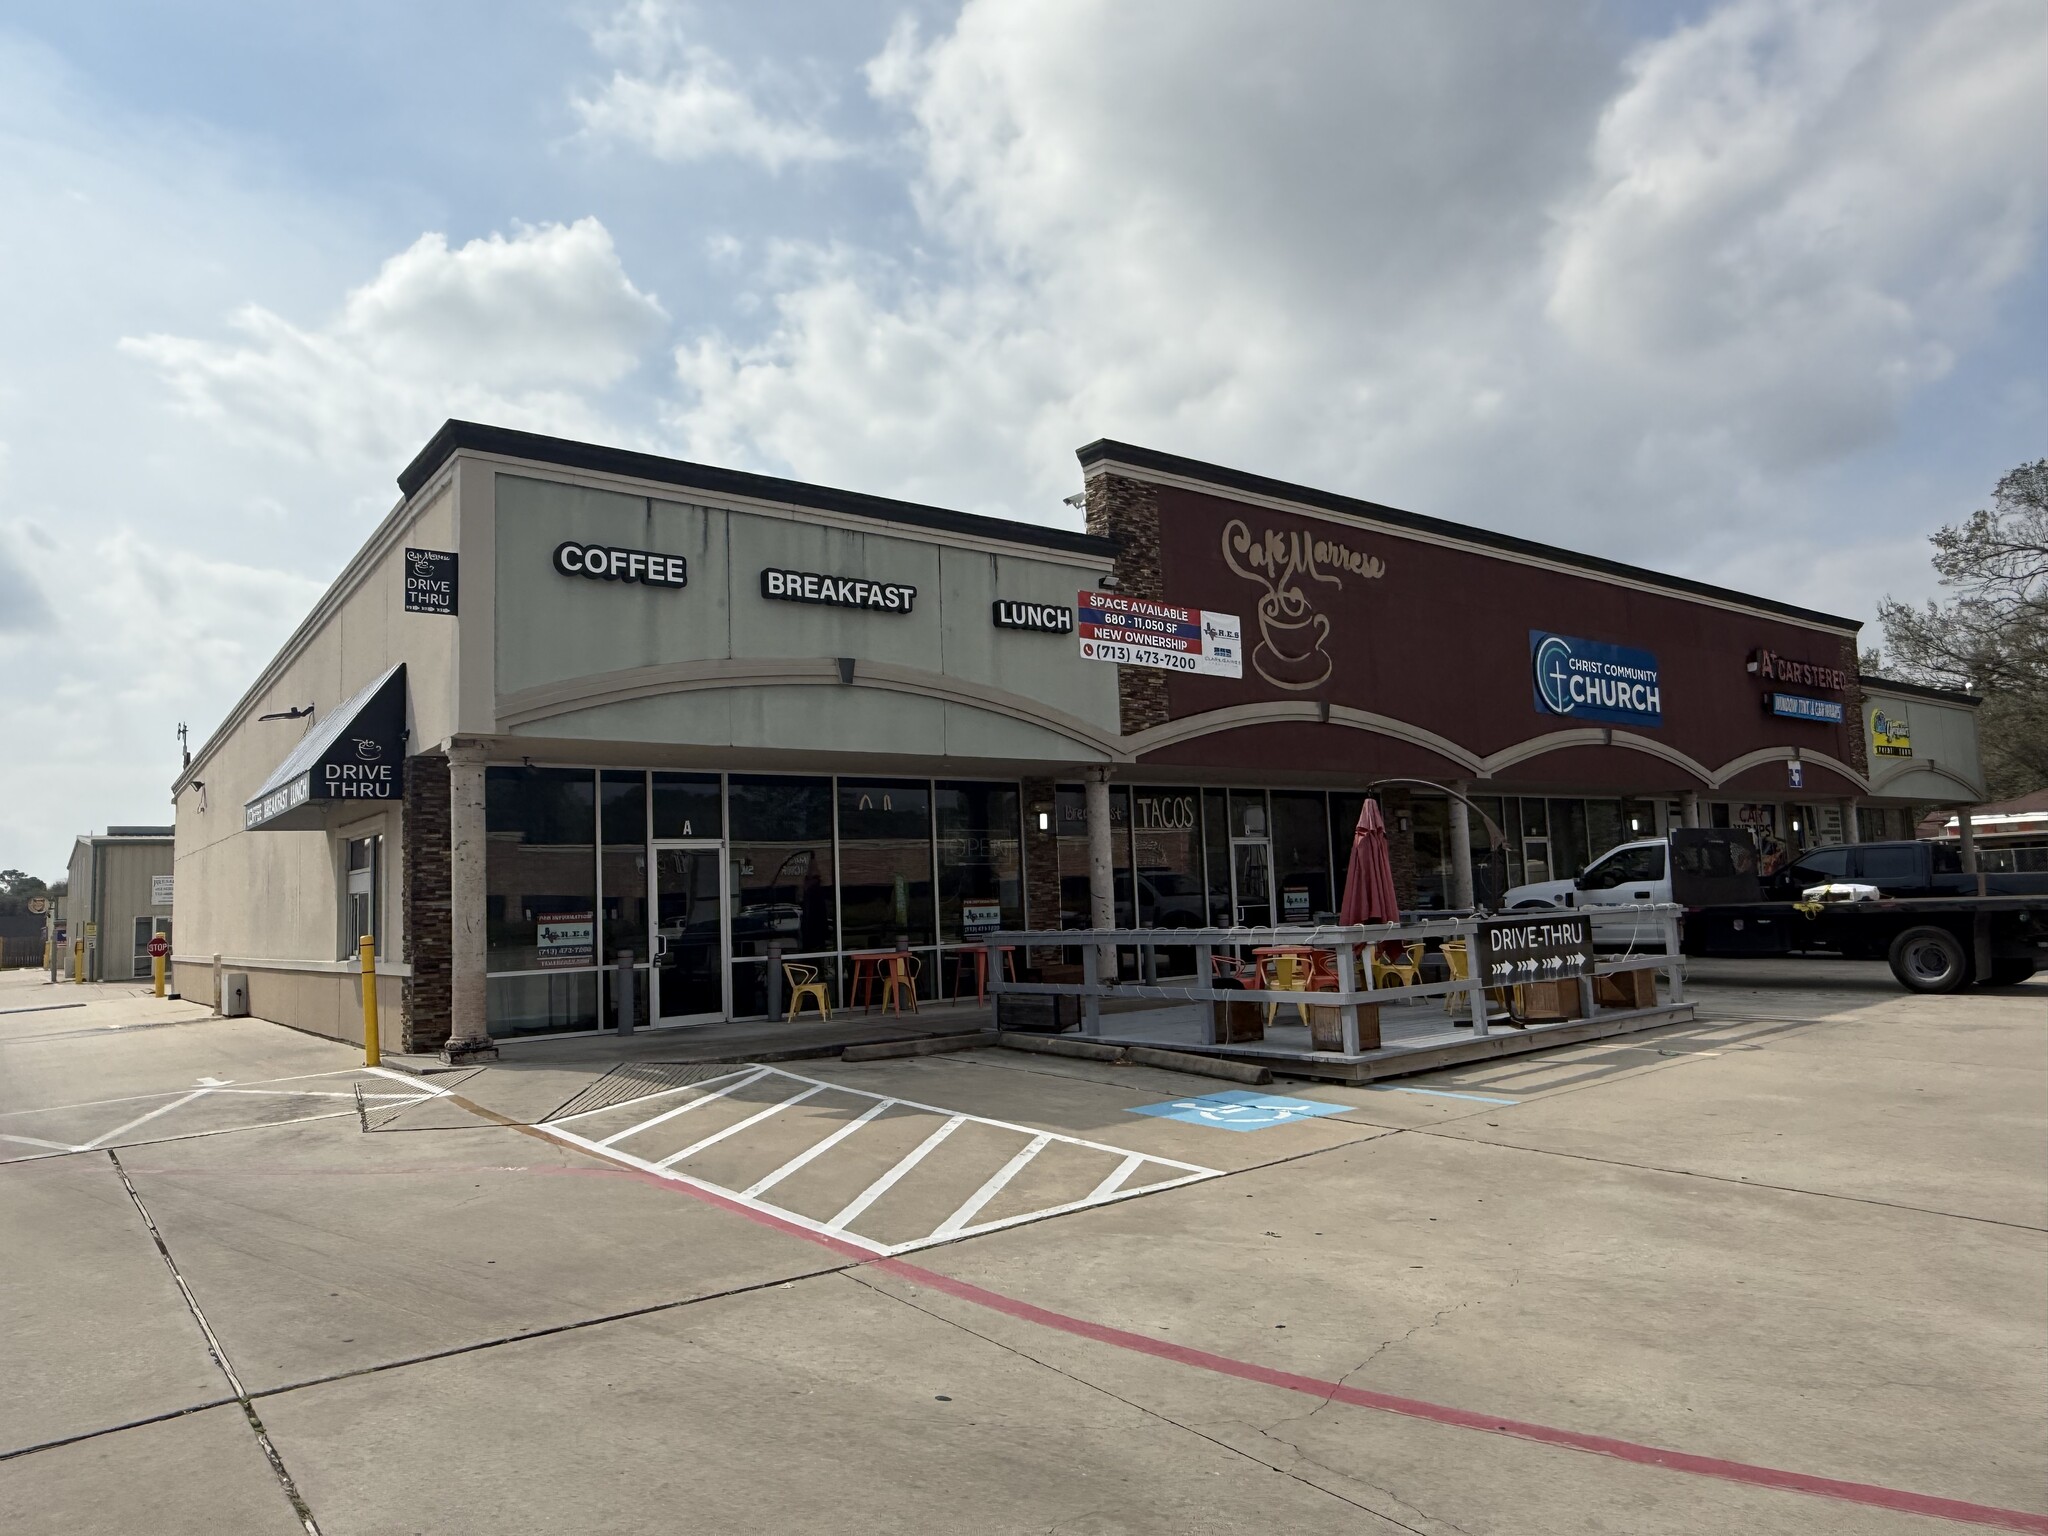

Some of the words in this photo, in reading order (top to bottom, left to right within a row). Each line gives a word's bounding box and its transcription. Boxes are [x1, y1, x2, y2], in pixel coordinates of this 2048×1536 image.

[560, 546, 684, 583] COFFEE
[407, 577, 450, 593] DRIVE
[768, 571, 914, 609] BREAKFAST
[408, 591, 449, 606] THRU
[1090, 594, 1128, 611] SPACE
[1130, 602, 1189, 622] AVAILABLE
[1000, 602, 1071, 630] LUNCH
[1104, 613, 1126, 626] 680
[1133, 617, 1164, 632] 11,050
[1165, 622, 1178, 634] SF
[1094, 627, 1123, 641] NEW
[1124, 631, 1188, 651] OWNERSHIP
[1096, 643, 1131, 662] (713)
[1135, 650, 1196, 670] 473-7200
[1568, 657, 1602, 674] CHRIST
[1604, 663, 1658, 683] COMMUNITY
[1777, 659, 1802, 683] CAR
[1803, 664, 1847, 691] STEREO
[1569, 674, 1661, 713] CHURCH
[325, 764, 392, 780] DRIVE
[325, 781, 390, 798] THRU
[263, 789, 288, 819] BREAKFAST
[1136, 796, 1194, 829] TACOS
[1739, 807, 1763, 823] CAR
[683, 820, 692, 835] A
[149, 944, 167, 952] STOP
[1490, 922, 1583, 952] DRIVE-THRU
